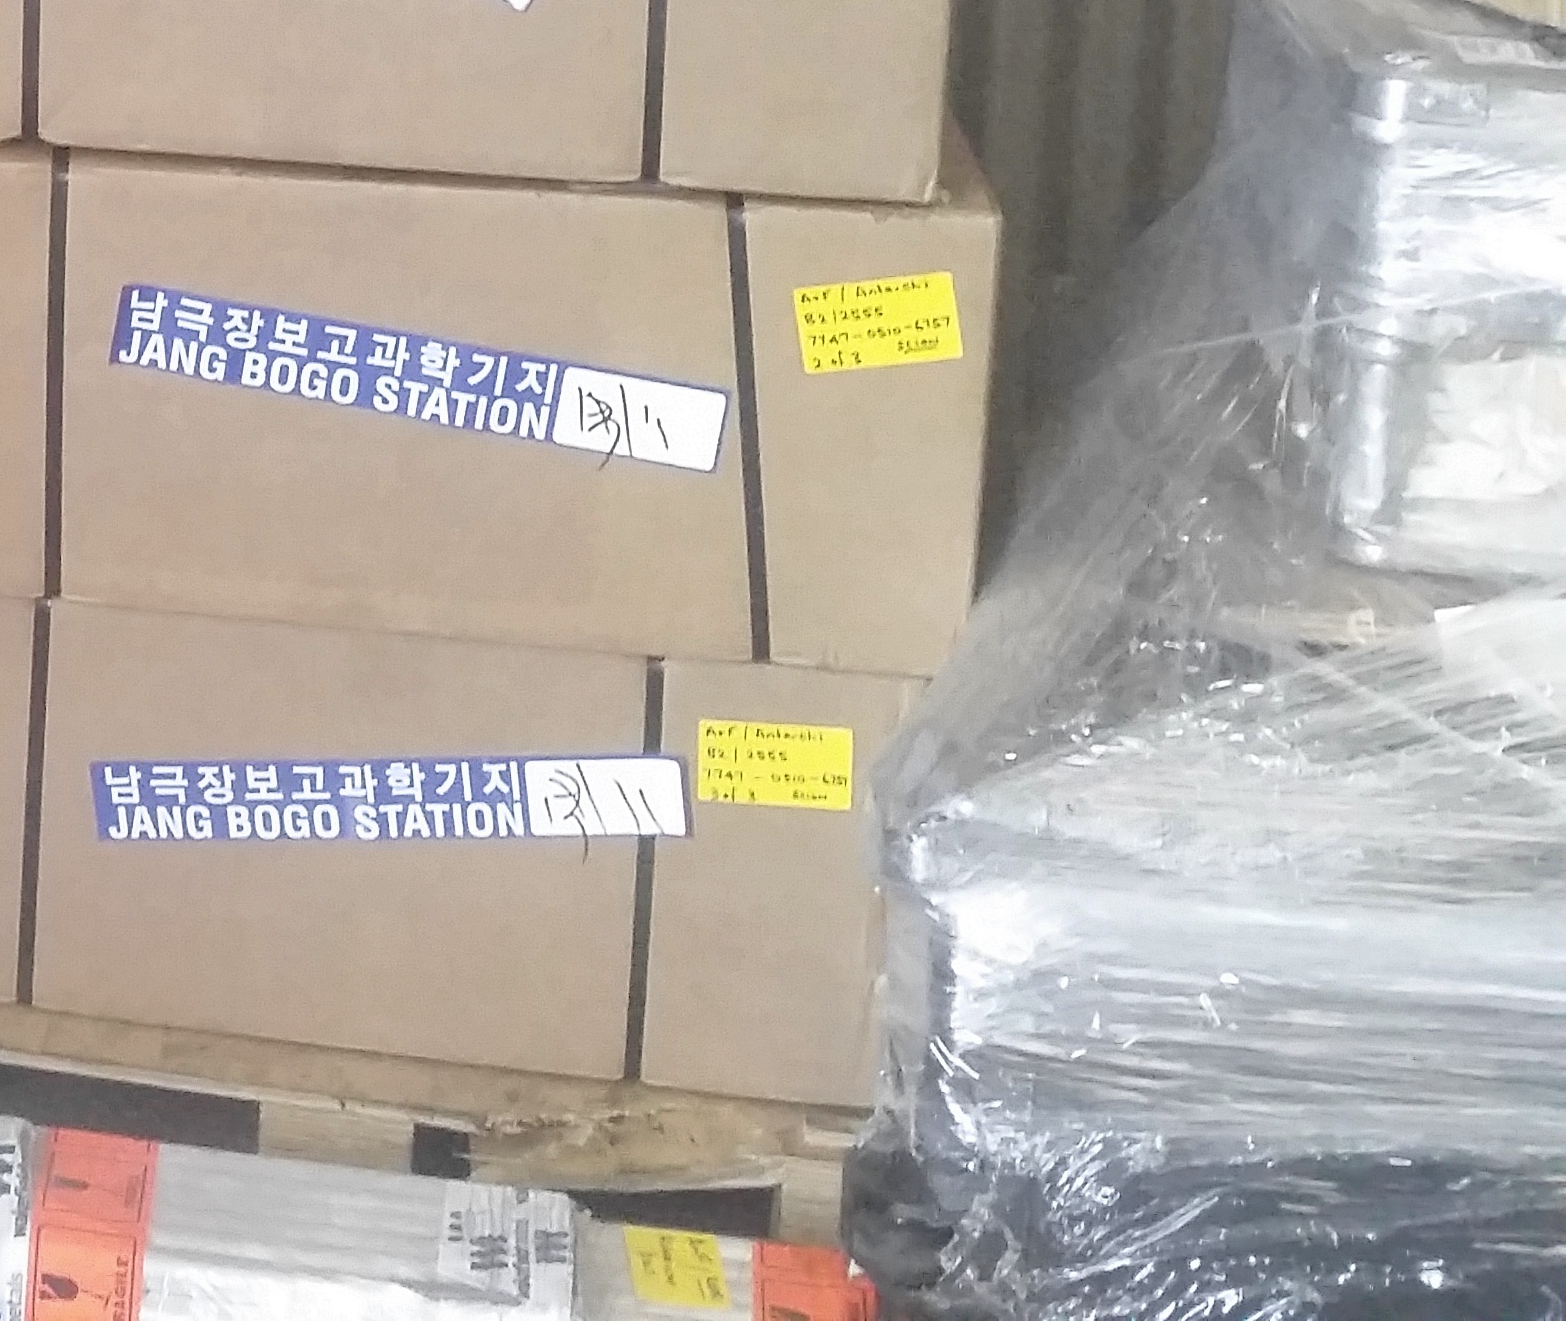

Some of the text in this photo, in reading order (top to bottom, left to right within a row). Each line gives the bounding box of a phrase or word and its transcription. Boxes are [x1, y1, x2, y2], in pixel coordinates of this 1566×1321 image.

[119, 329, 552, 441] JANG BOGO STATION
[130, 289, 559, 405] 남극장보고과학기지
[104, 762, 522, 804] 남극장보고과학기지
[108, 803, 526, 842] JANG BOGO STATION
